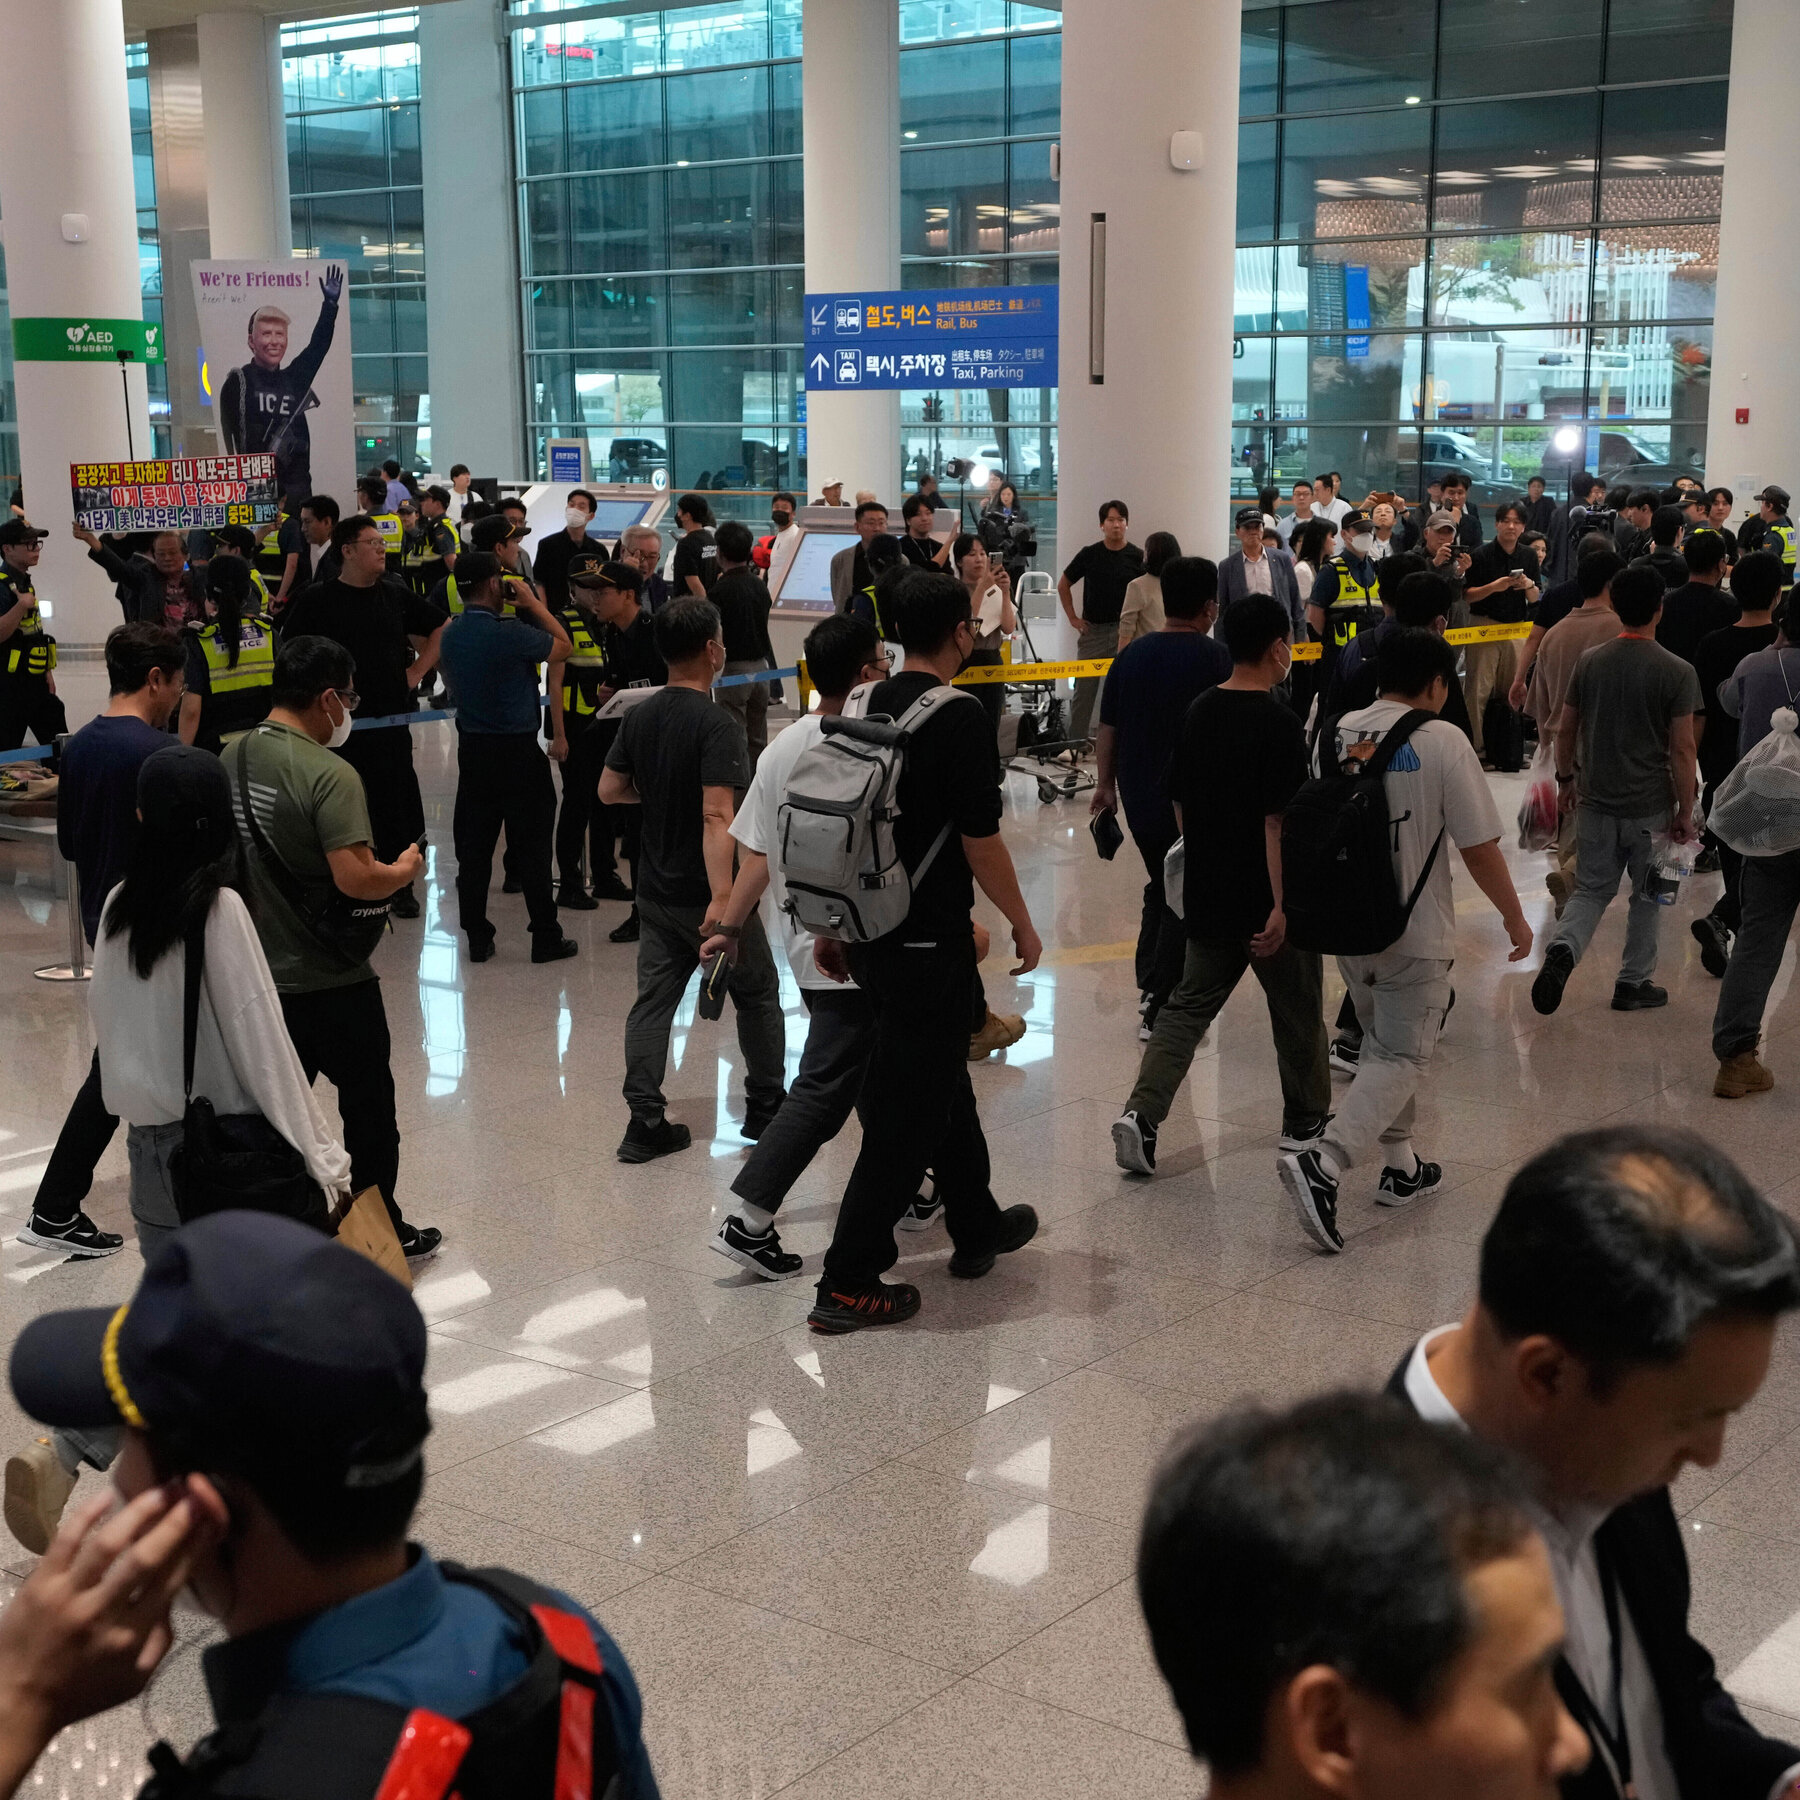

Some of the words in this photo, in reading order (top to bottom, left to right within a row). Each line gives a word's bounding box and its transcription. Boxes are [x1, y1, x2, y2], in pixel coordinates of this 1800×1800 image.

[199, 271, 241, 287] We're
[247, 270, 310, 287] Friends!
[866, 304, 932, 329] 철도,버스
[936, 318, 956, 330] Rail,
[960, 317, 978, 329] Bus
[86, 332, 113, 343] AED
[811, 328, 820, 336] B1
[840, 352, 855, 360] TAXI
[866, 353, 946, 379] 택시,주차장
[952, 367, 977, 381] Taxi,
[980, 366, 1024, 381] Parking
[259, 392, 290, 415] ICE
[172, 460, 193, 482] 더니
[196, 457, 238, 481] 체포구금
[240, 455, 276, 479] 날벼락!
[112, 486, 140, 508] 이게
[142, 484, 182, 508] 동맹에
[228, 504, 254, 525] 중단!
